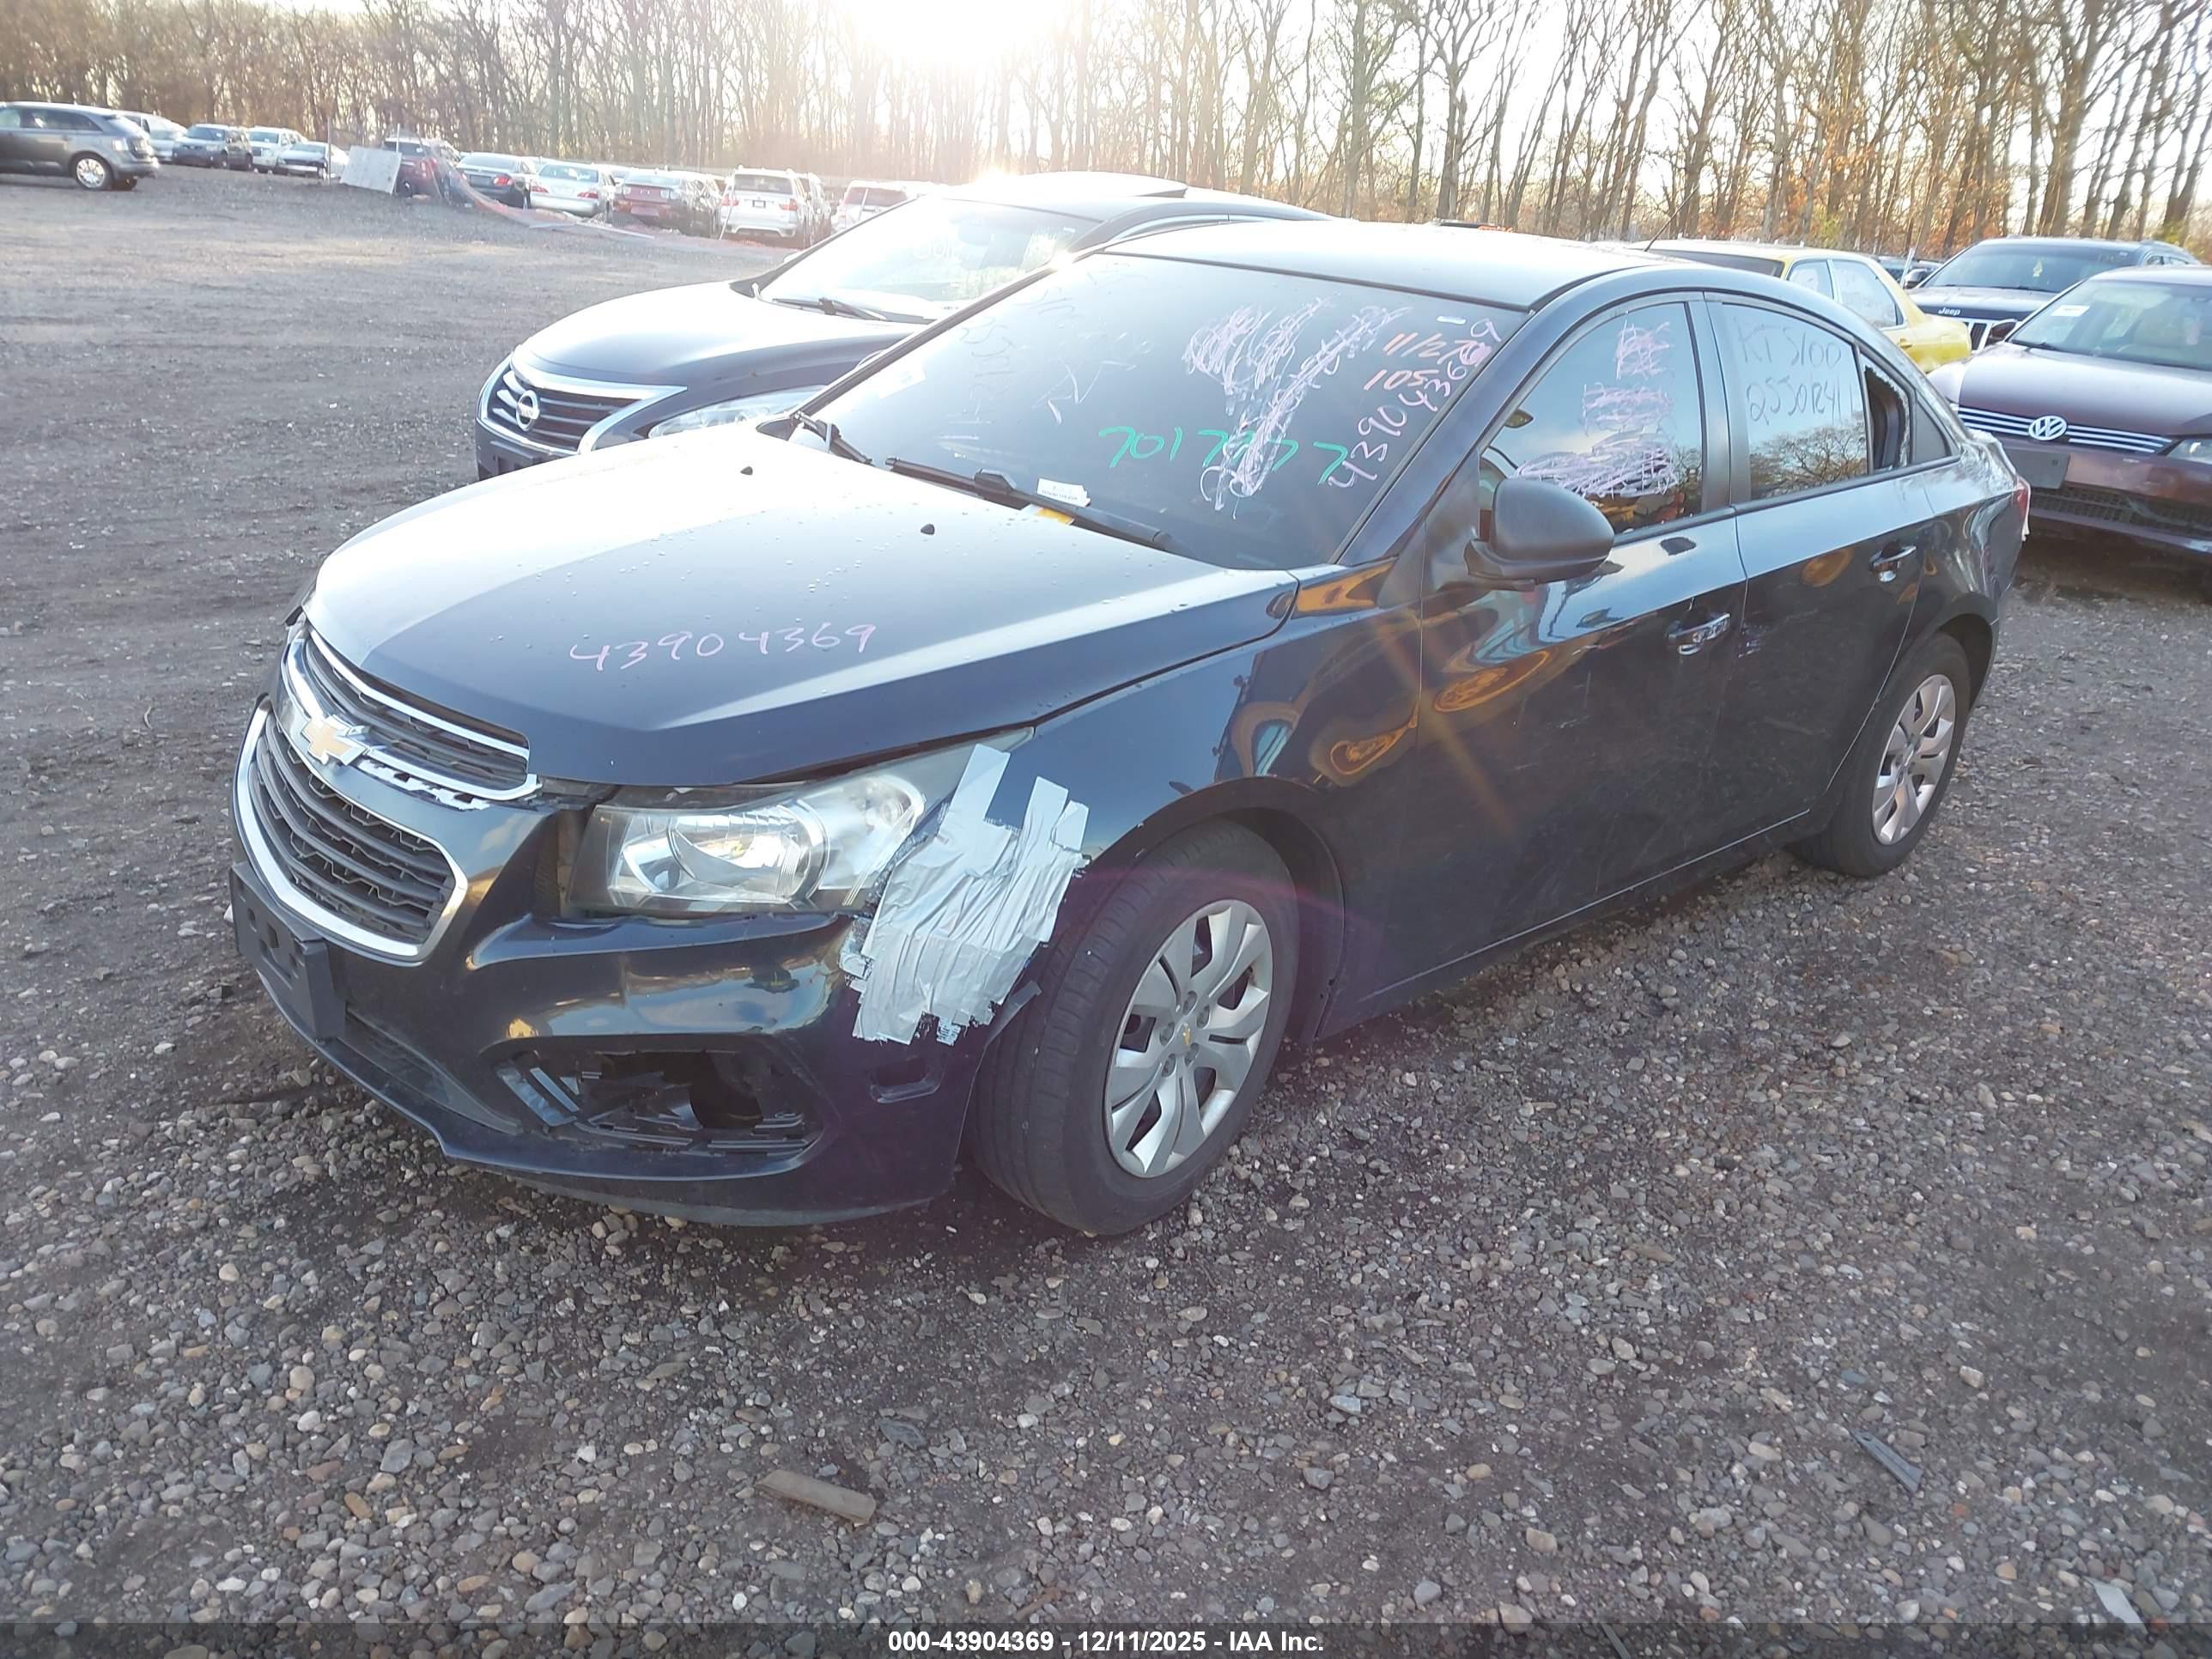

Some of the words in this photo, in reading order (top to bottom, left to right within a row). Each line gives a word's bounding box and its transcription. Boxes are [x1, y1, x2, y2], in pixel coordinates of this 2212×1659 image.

[1938, 306, 1962, 317] Jeep
[1328, 317, 1503, 489] 43904369
[569, 622, 878, 672] 43904369
